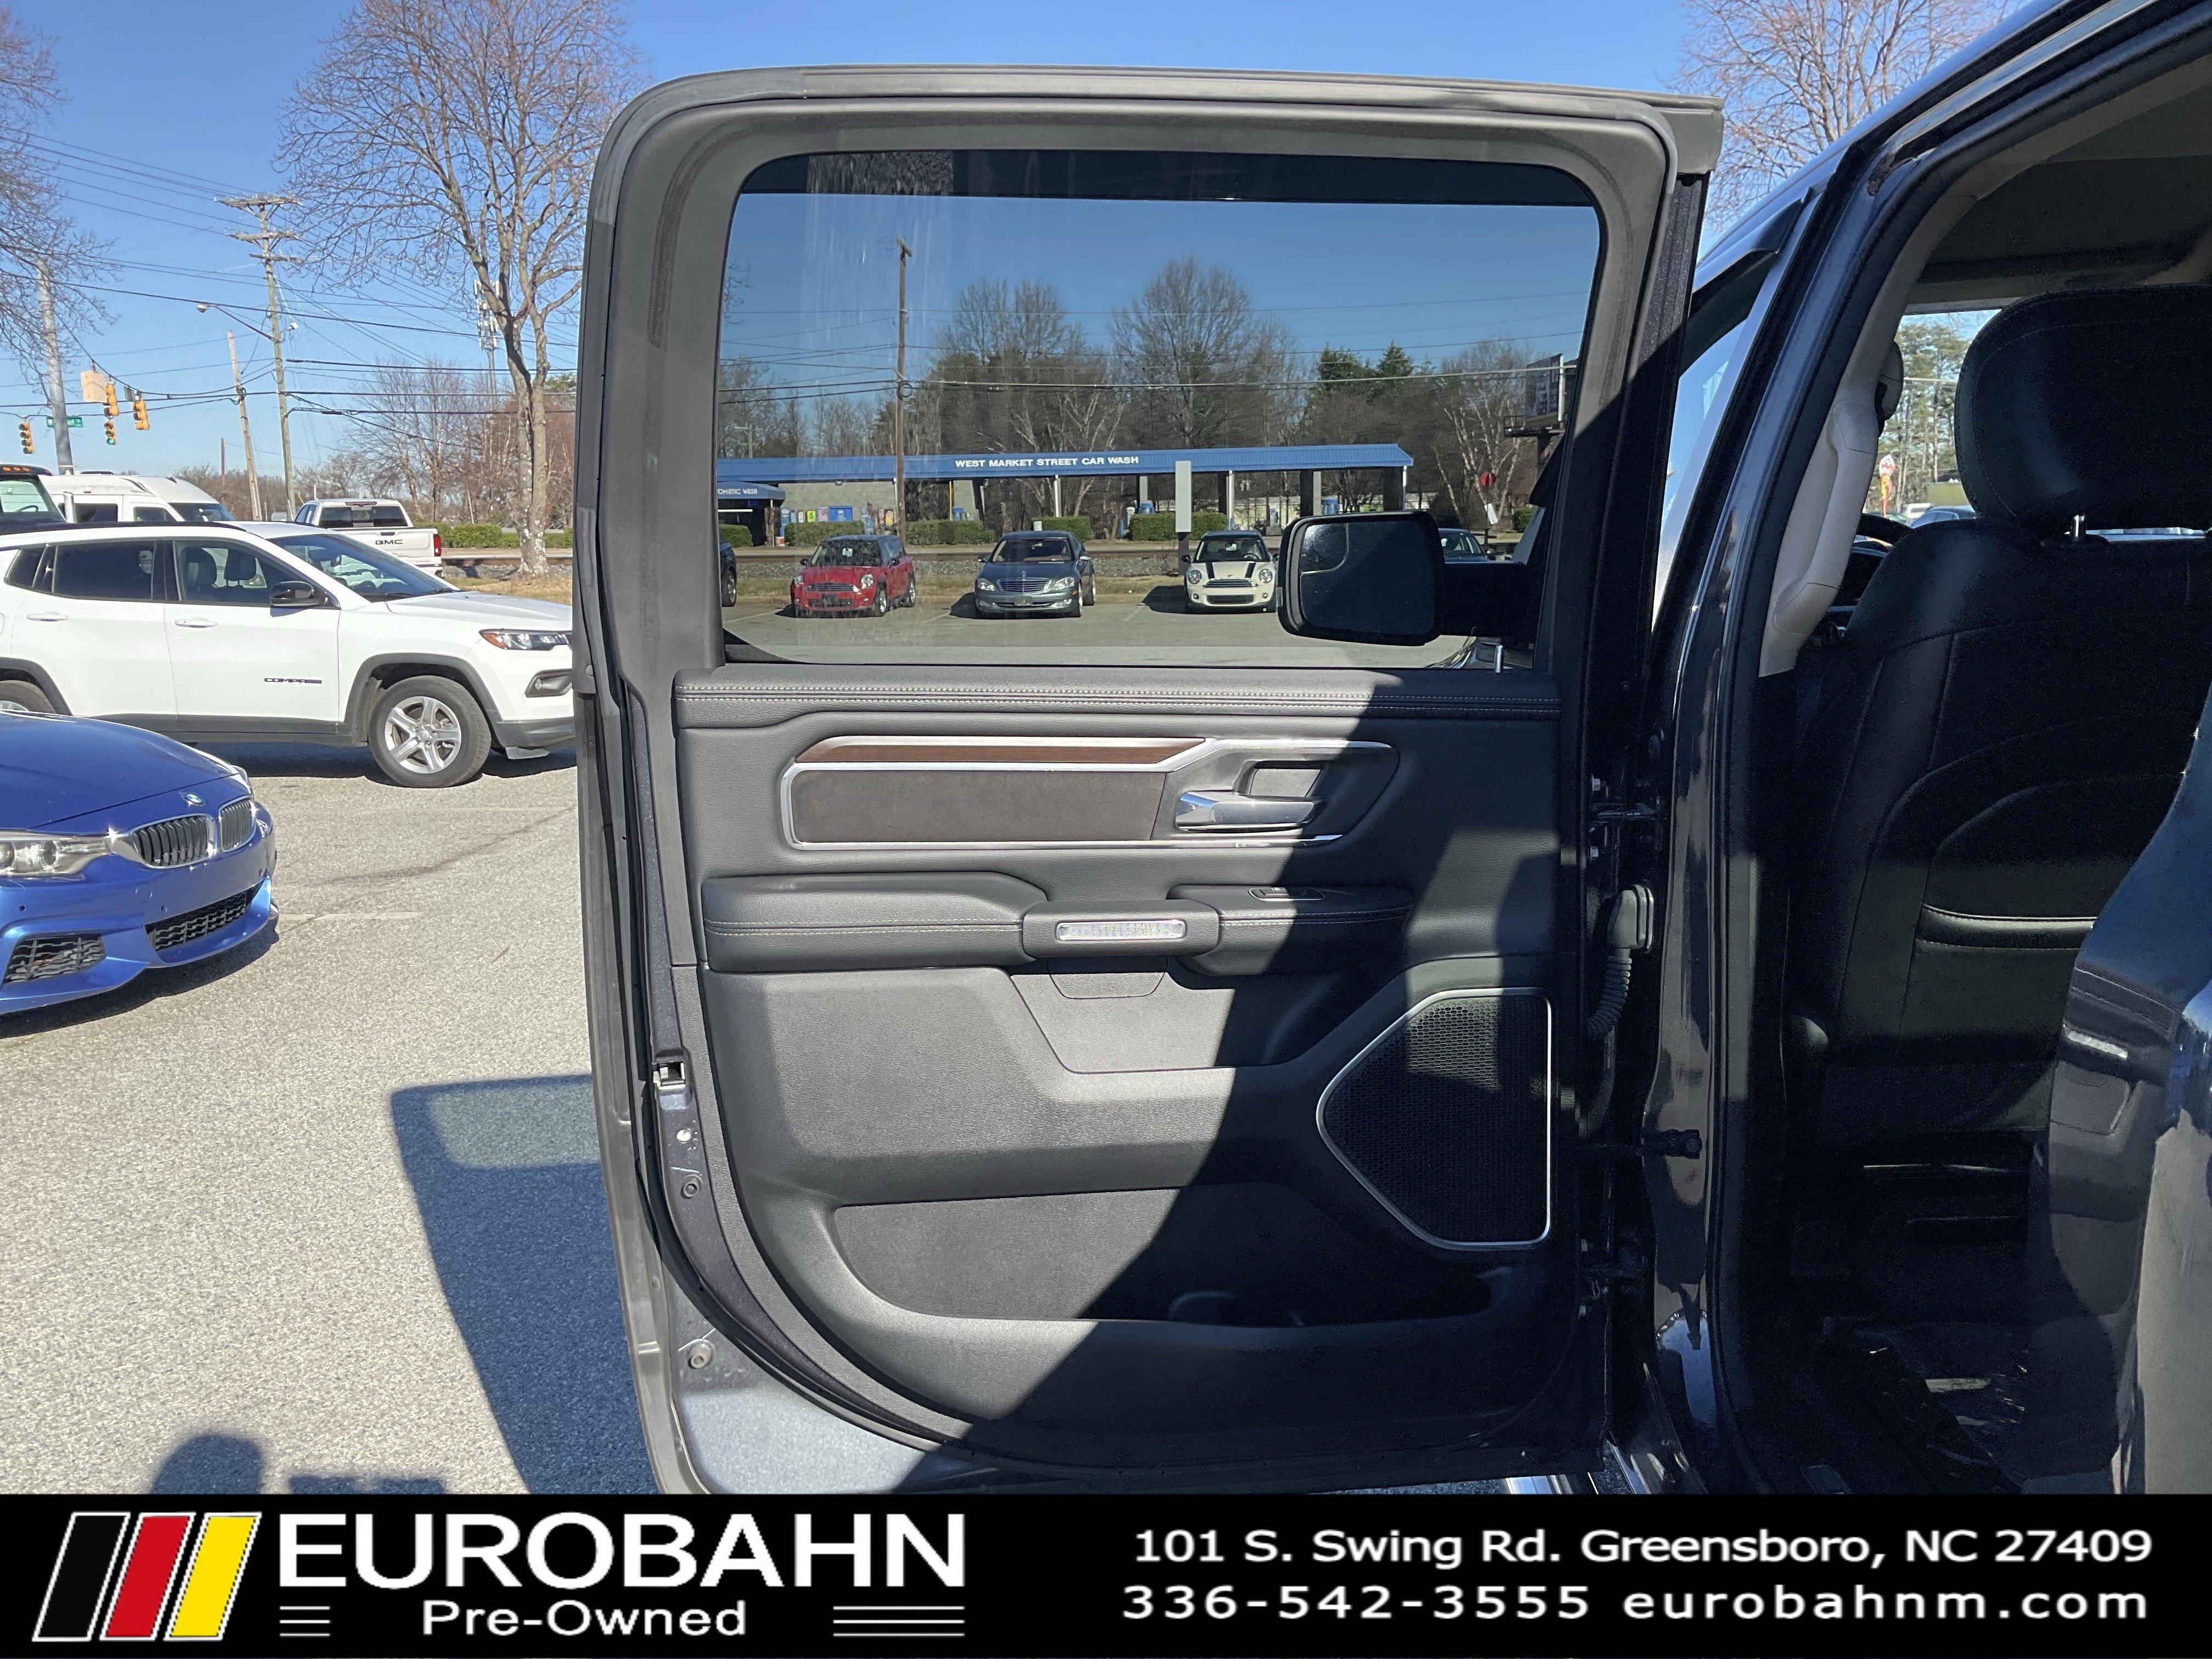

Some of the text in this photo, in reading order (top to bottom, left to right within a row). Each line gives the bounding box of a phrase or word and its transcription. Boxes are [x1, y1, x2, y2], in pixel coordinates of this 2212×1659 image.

[989, 459, 1033, 467] MARKET
[1036, 458, 1078, 466] STREET
[1081, 457, 1105, 465] CAR
[1108, 456, 1139, 464] WASH
